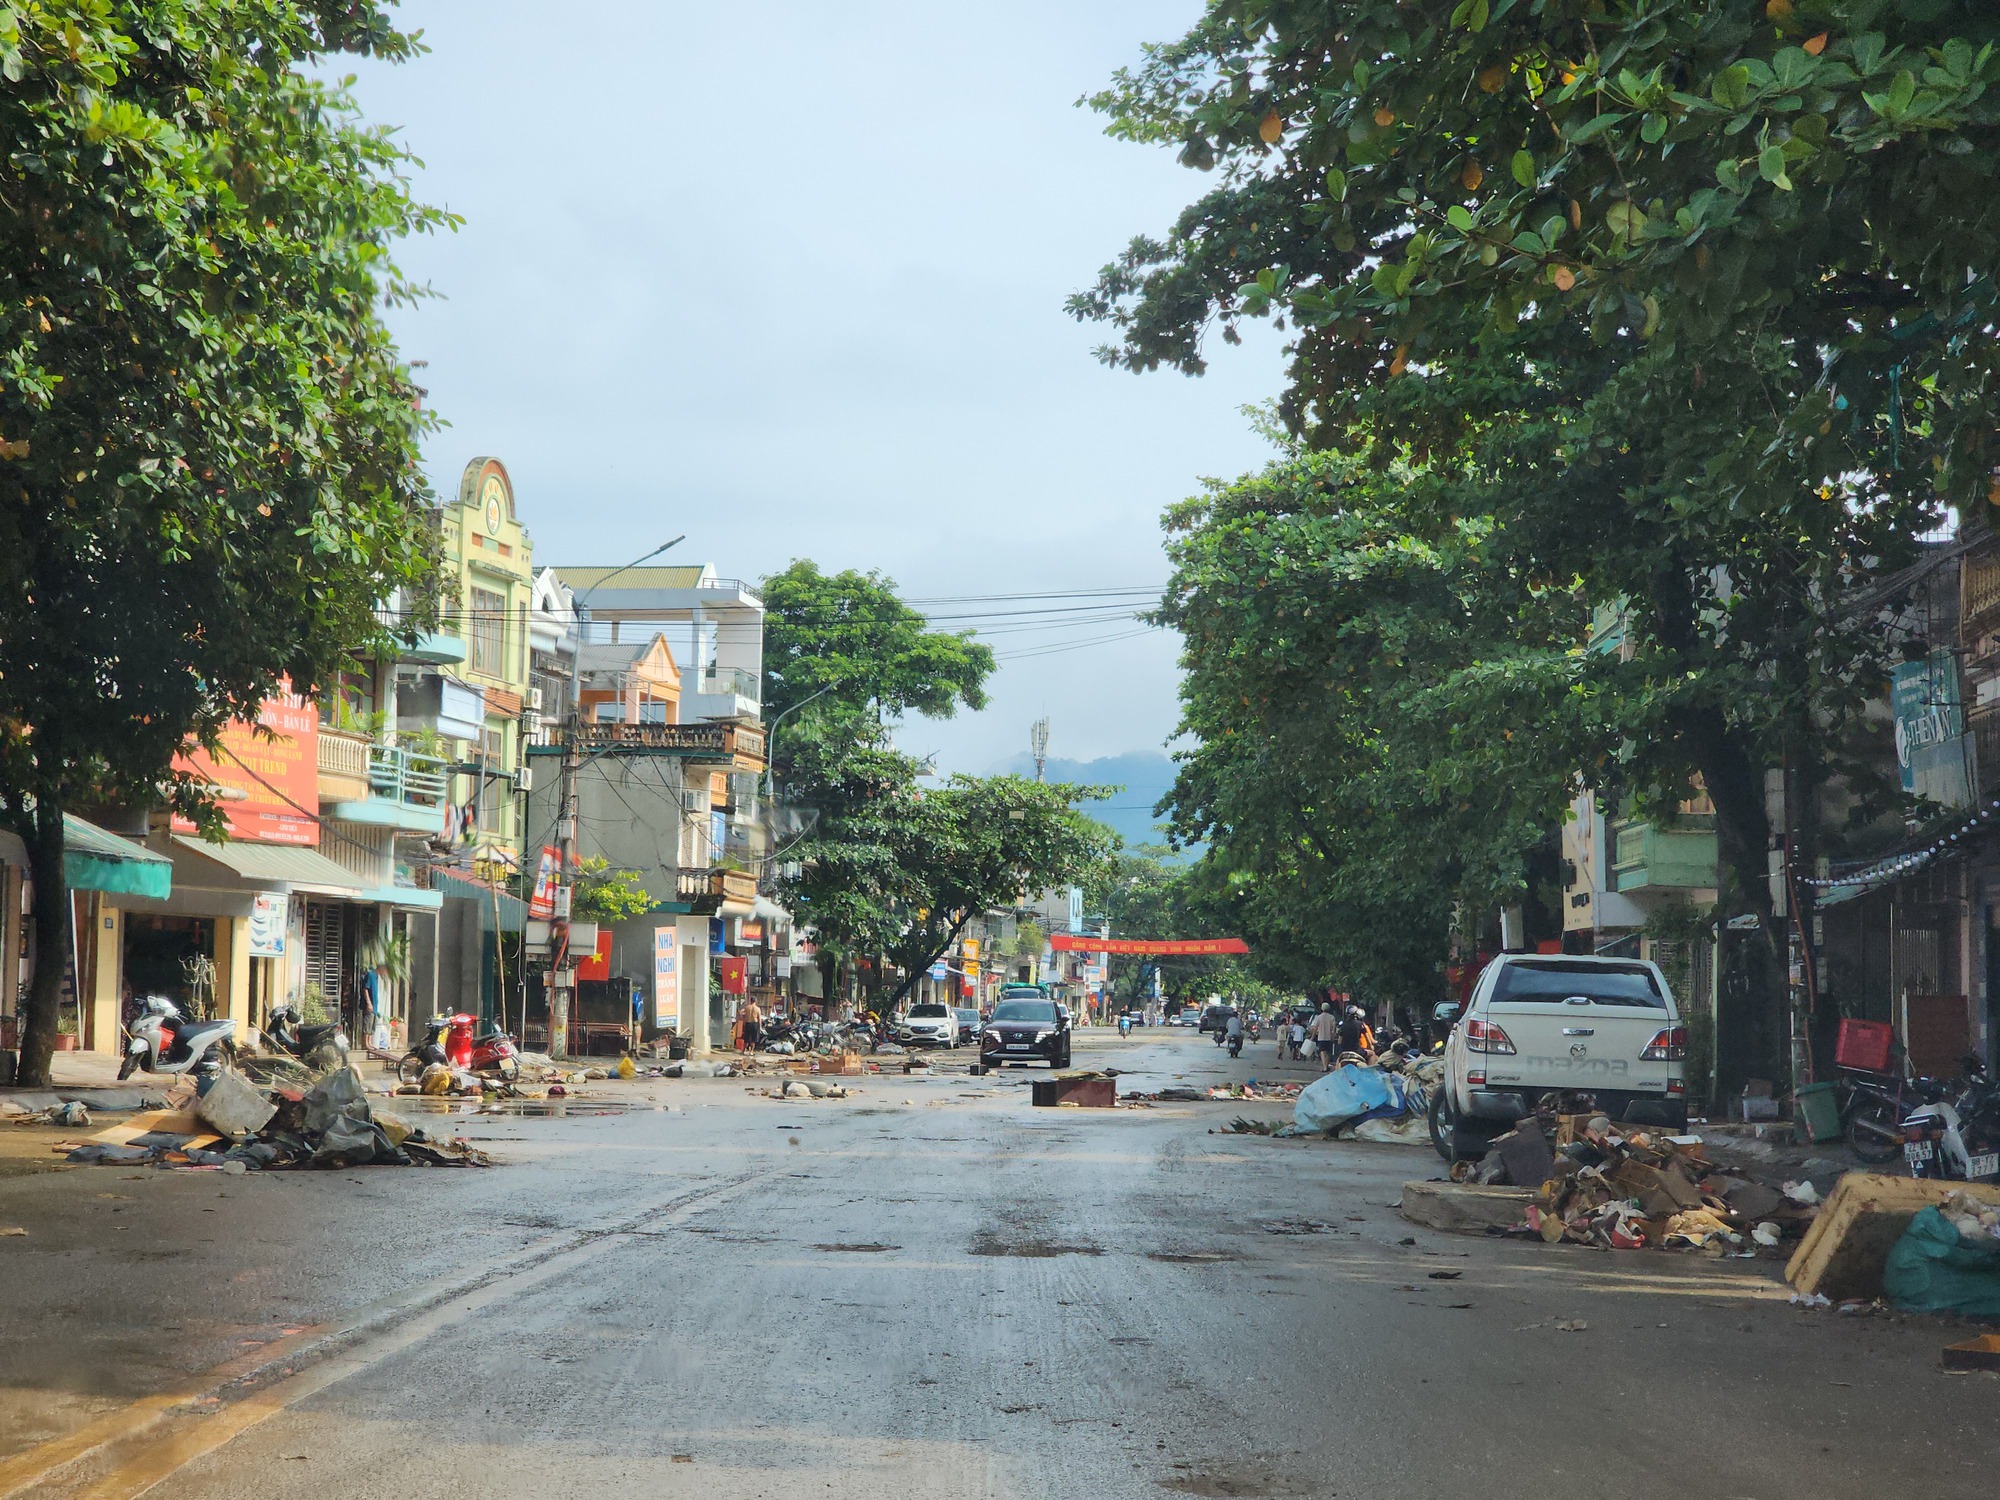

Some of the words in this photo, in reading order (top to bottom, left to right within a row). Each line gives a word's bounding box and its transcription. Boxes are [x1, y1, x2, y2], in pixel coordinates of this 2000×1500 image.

[239, 755, 256, 772] HOT
[259, 758, 287, 776] TREND
[658, 930, 673, 950] NHÀ
